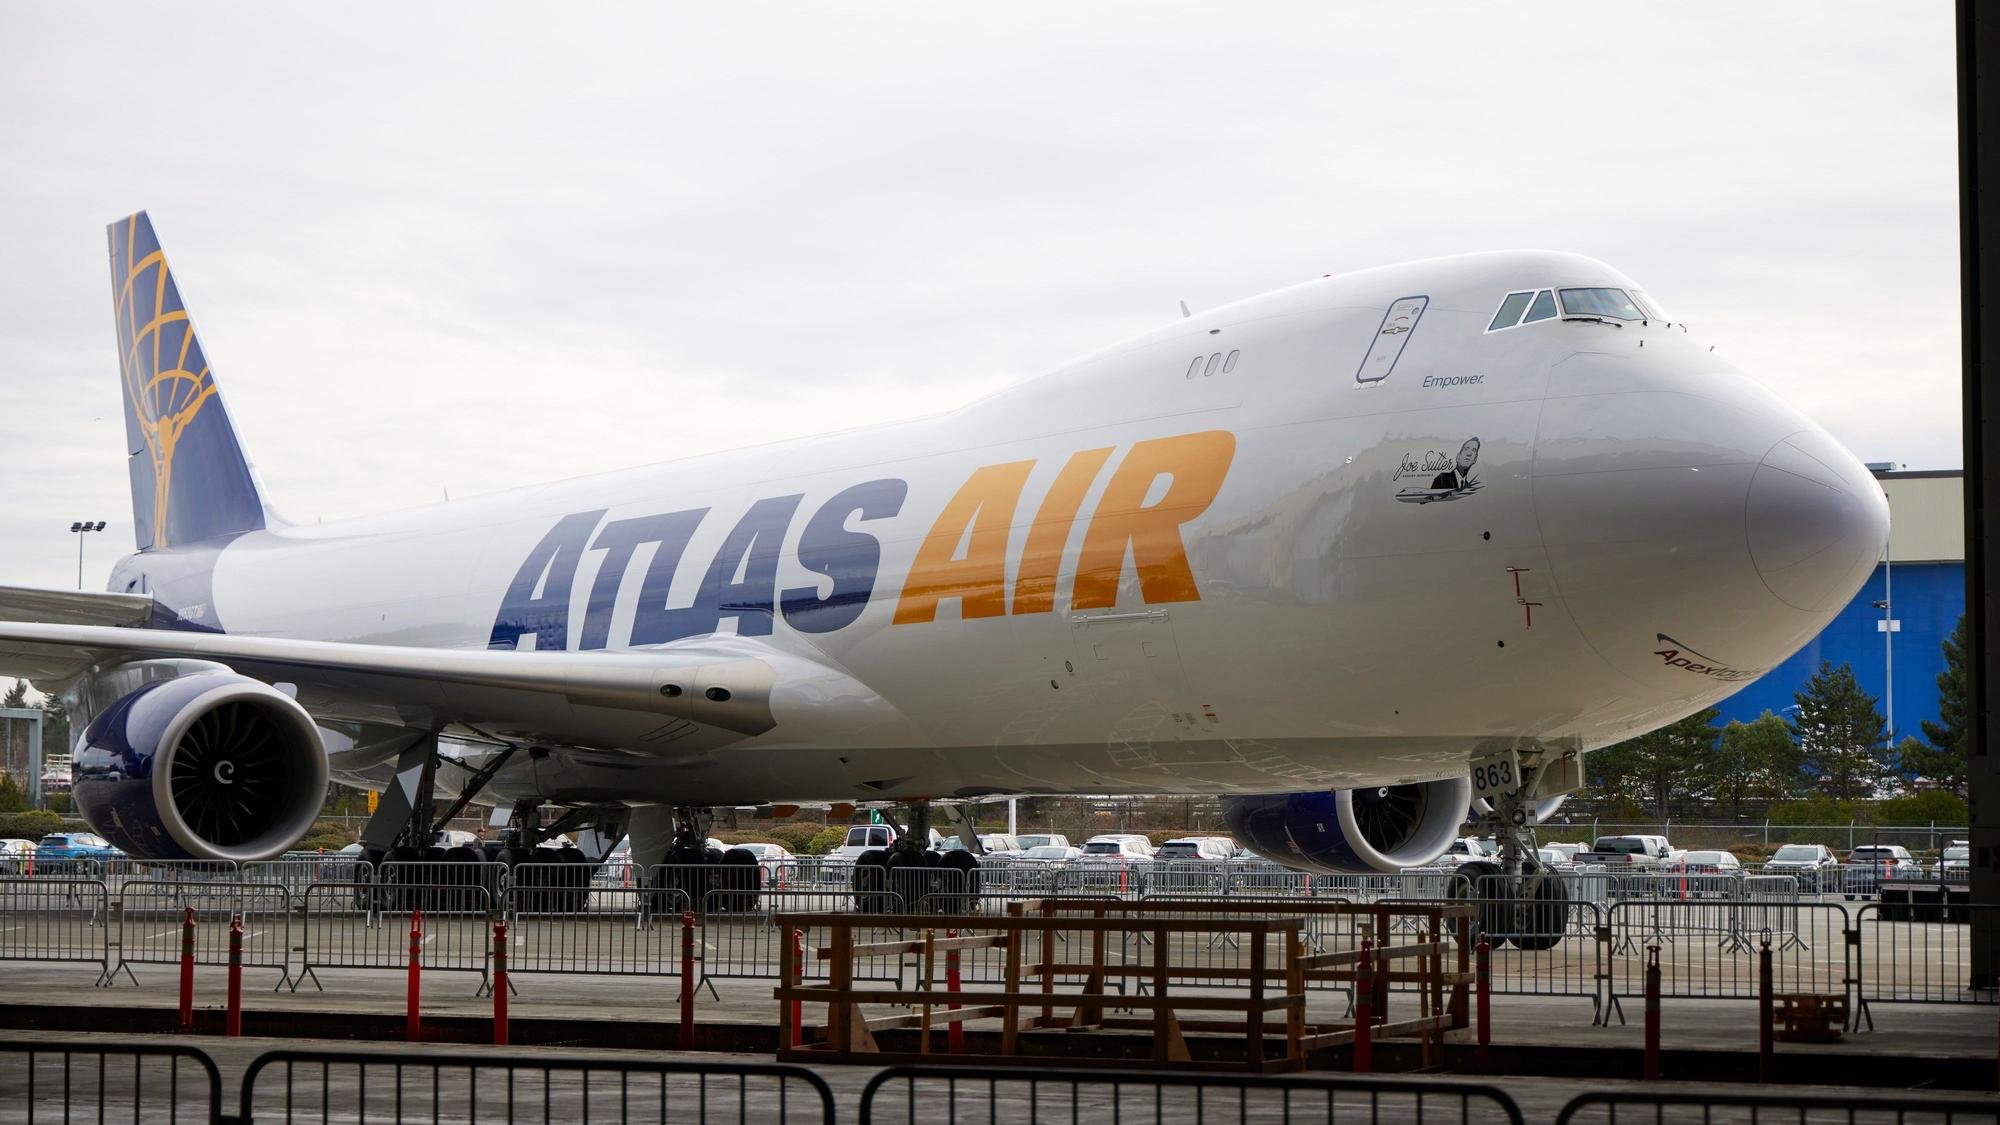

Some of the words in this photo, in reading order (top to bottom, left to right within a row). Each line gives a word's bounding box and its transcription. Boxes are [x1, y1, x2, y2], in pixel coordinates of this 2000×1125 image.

[1422, 375, 1484, 389] Empower.
[1393, 452, 1419, 481] Joe
[1421, 450, 1454, 472] Sutter
[487, 478, 908, 651] ATLAS
[892, 430, 1236, 625] AIR
[1474, 760, 1512, 791] 863
